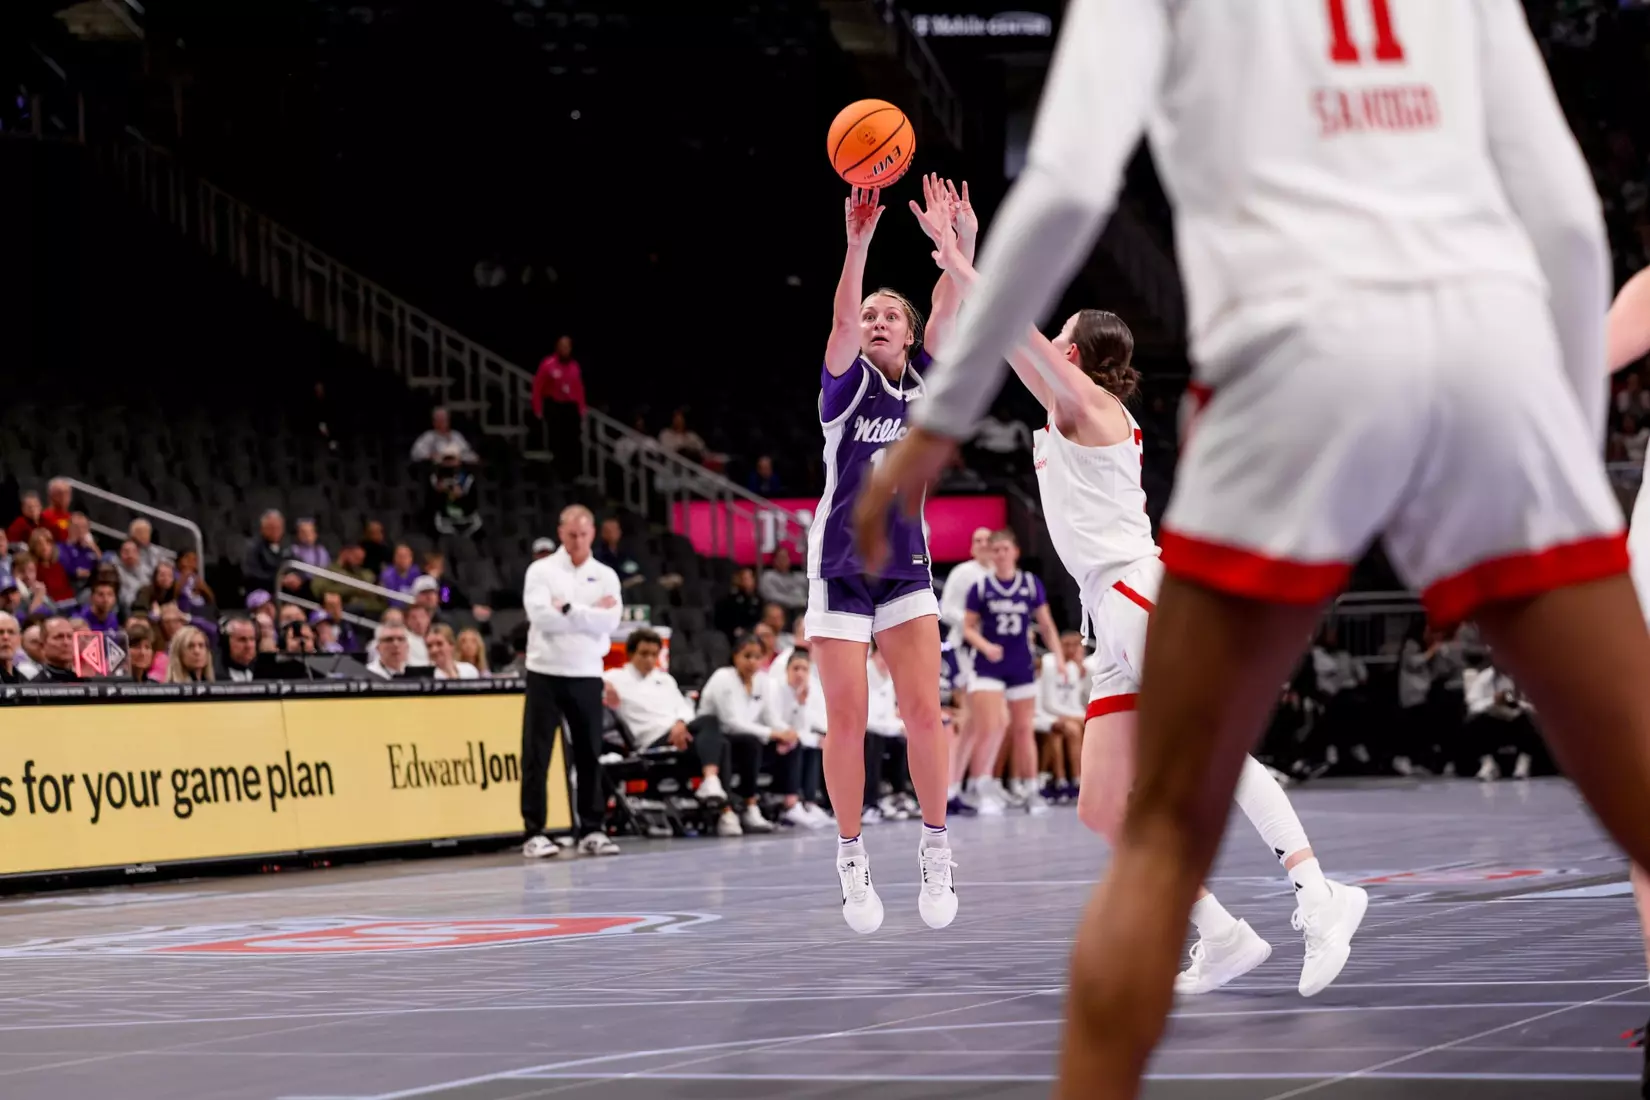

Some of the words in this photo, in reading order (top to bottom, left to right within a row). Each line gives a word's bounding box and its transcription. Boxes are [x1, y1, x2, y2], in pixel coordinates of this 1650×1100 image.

[996, 613, 1022, 635] 23
[22, 759, 75, 814] for
[82, 770, 162, 825] your
[171, 764, 262, 819] game
[266, 749, 335, 812] plan
[386, 741, 477, 790] Edward
[478, 740, 521, 791] Jon
